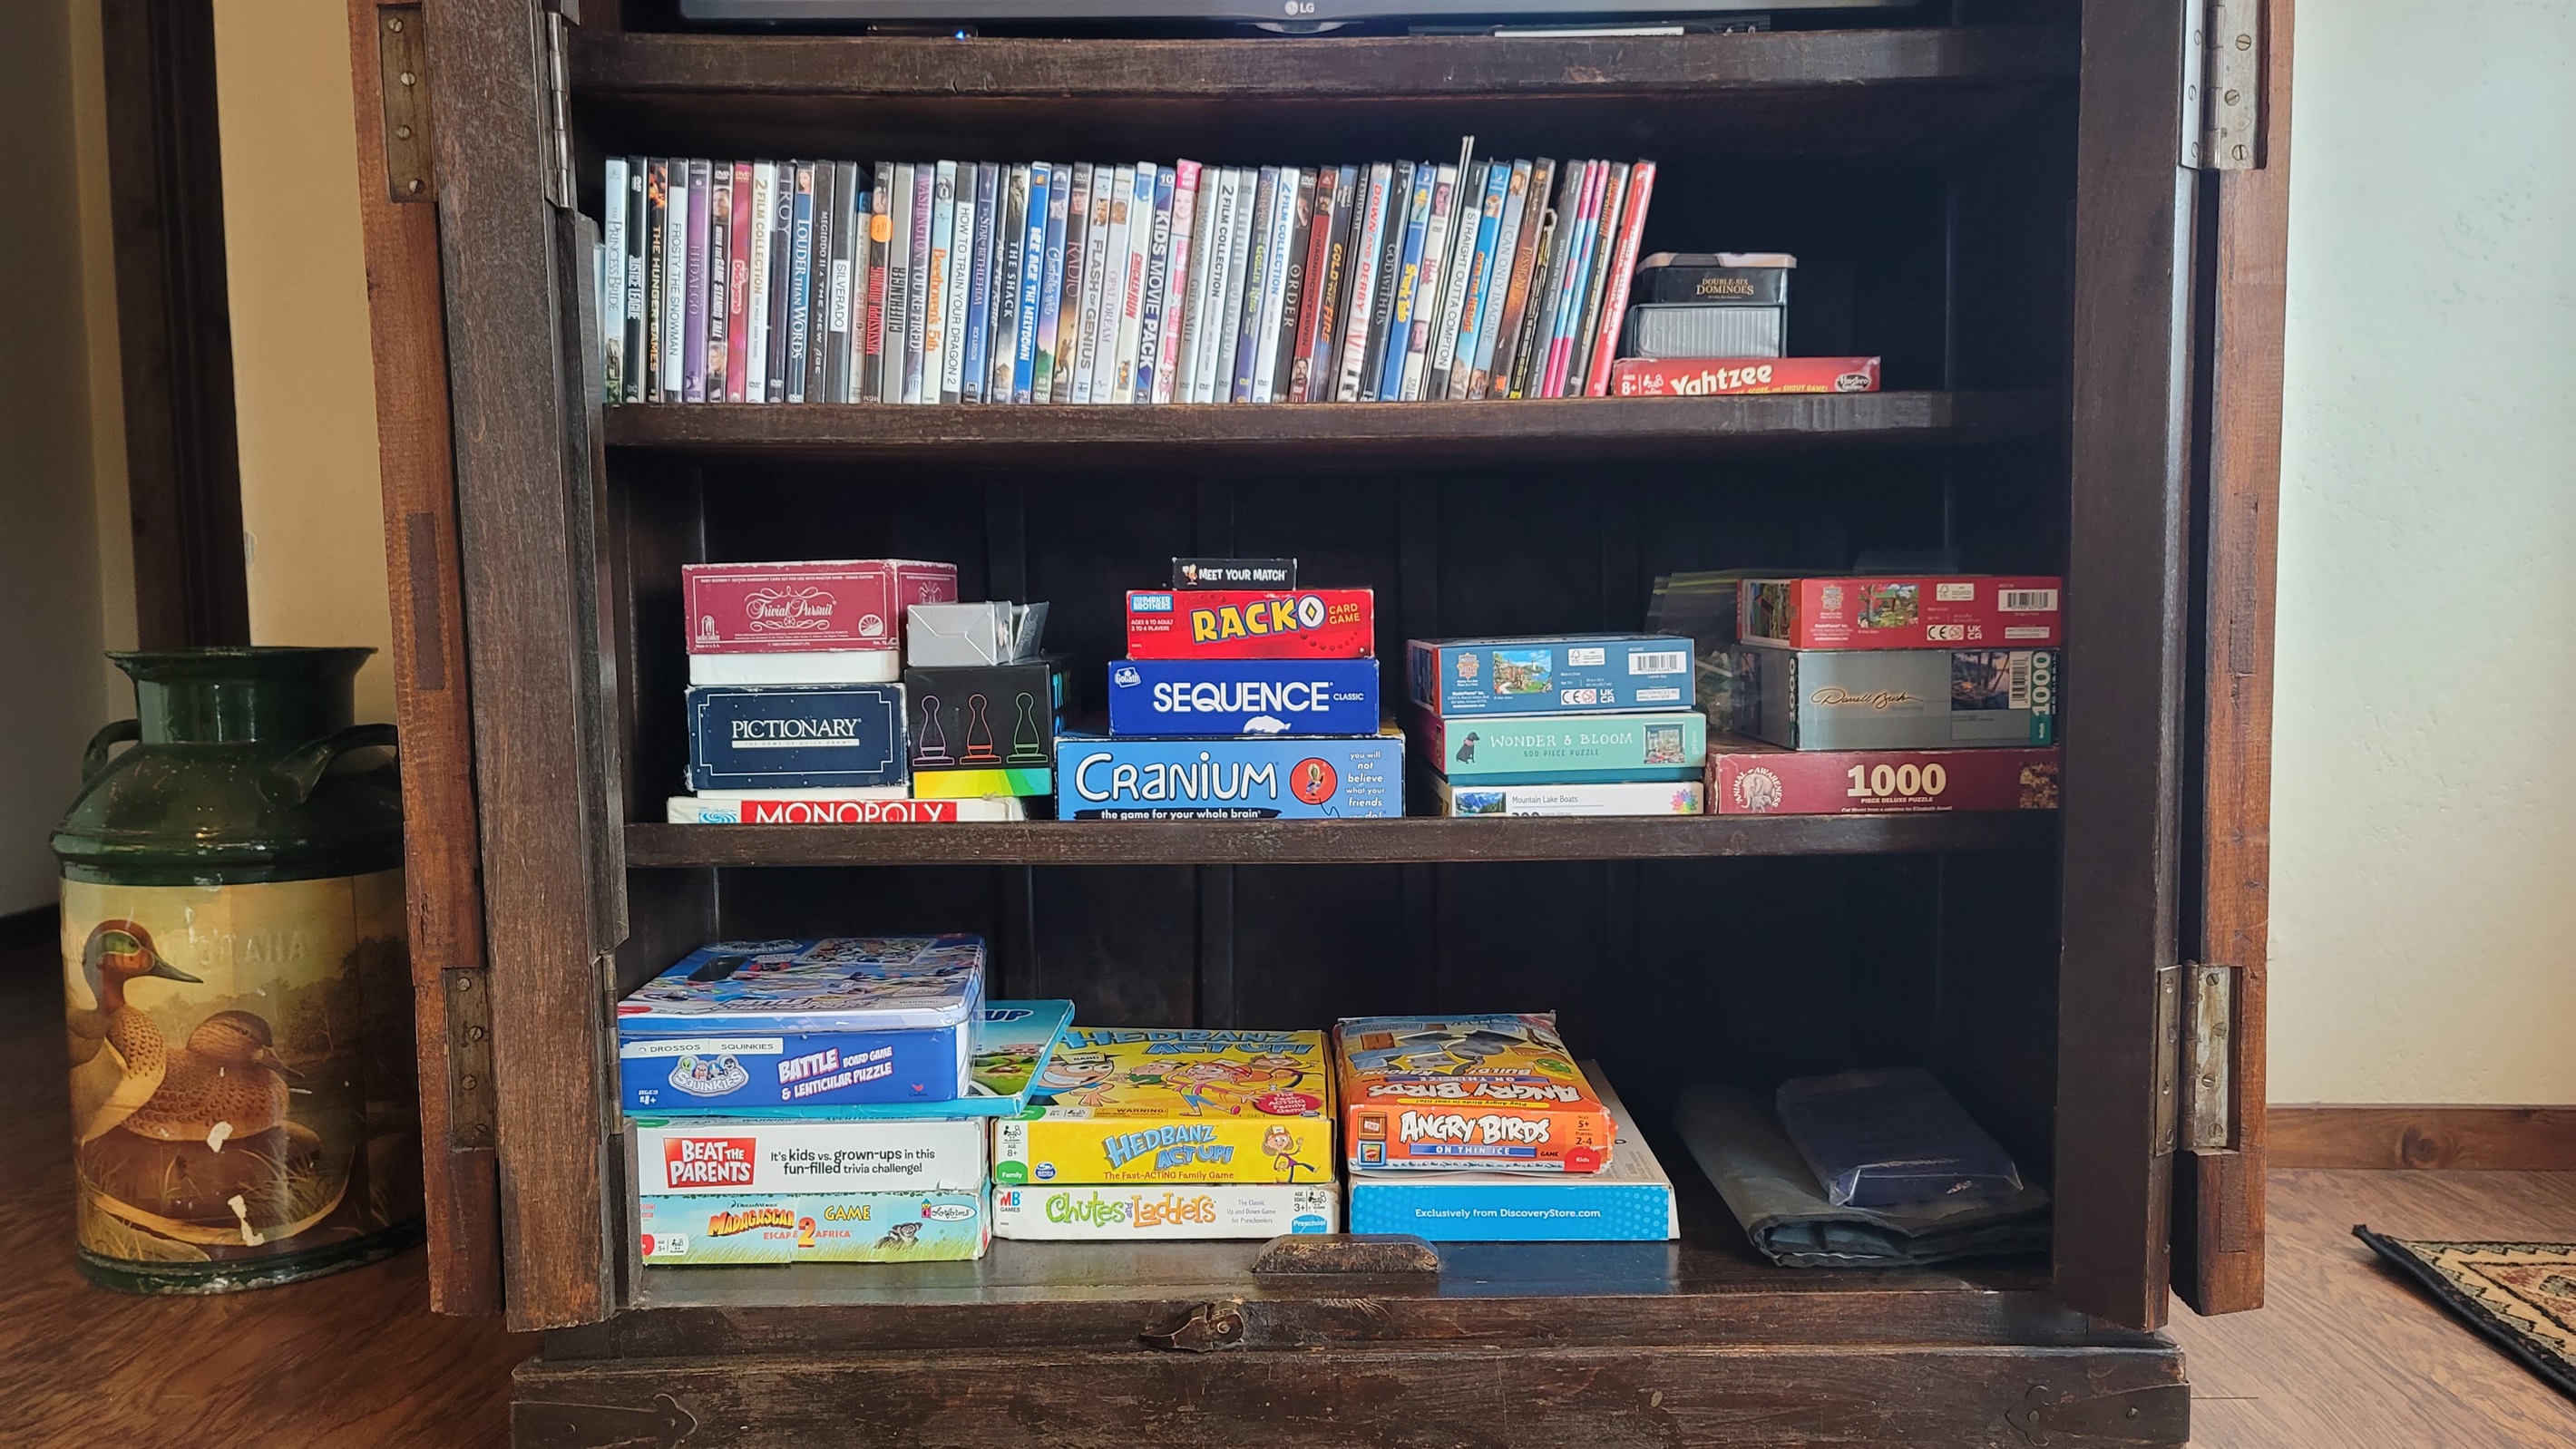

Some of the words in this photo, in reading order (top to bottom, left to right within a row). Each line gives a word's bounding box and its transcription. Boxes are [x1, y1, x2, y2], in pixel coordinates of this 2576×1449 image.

[1300, 2, 1315, 14] LG
[755, 180, 768, 190] 2
[756, 192, 766, 219] FILM
[912, 176, 930, 263] WASHINGTON,
[1368, 184, 1382, 232] DOWN
[958, 208, 970, 236] HOW
[1152, 209, 1169, 256] KIDS
[608, 221, 623, 276] PRINCESS
[652, 226, 661, 254] THE
[671, 222, 682, 267] FROSTY
[795, 219, 809, 276] LOUDER
[957, 238, 968, 254] TO
[1029, 227, 1041, 252] ICE
[1364, 235, 1373, 258] AND
[1458, 211, 1477, 267] STRAIGHT
[1499, 229, 1513, 255] CAN
[754, 222, 766, 295] COLLECTION
[1009, 241, 1020, 267] THE
[1027, 254, 1040, 282] AGE
[1089, 238, 1103, 292] FLASH
[1472, 250, 1486, 278] OVER
[628, 255, 642, 288] JUSTICE
[670, 272, 681, 295] THE
[688, 246, 701, 315] HIDALGO
[954, 257, 967, 290] TRAIN
[1066, 242, 1082, 297] RADIO
[1493, 258, 1509, 291] ONLY
[1702, 277, 1749, 286] DOUBLE-SIX
[608, 276, 622, 311] BRIDE
[650, 257, 661, 318] HUNGER
[793, 277, 804, 305] THAN
[834, 264, 847, 328] SILVERADO
[889, 267, 906, 333] CLIFFHANGER
[911, 265, 927, 311] YOU'RE
[928, 248, 946, 325] Beethoven's
[1004, 271, 1016, 318] SHACK
[1024, 284, 1037, 305] THE
[1088, 294, 1097, 306] OF
[1147, 259, 1166, 315] MOVIE
[1283, 263, 1302, 328] ORDER
[1355, 262, 1371, 315] DERBY
[1449, 270, 1467, 308] OUTTA
[1470, 279, 1479, 295] THE
[1695, 284, 1754, 296] DOMINOES
[627, 288, 642, 320] LEAGUE
[951, 293, 964, 325] YOUR
[1462, 297, 1478, 333] HEDGE
[1483, 292, 1503, 343] IMAGINE
[668, 295, 681, 355] SNOWMAN
[792, 306, 806, 359] WORDS
[909, 314, 923, 353] FIRED!
[1019, 305, 1035, 361] MELTDOWN
[1080, 308, 1097, 370] GENIUS
[1438, 310, 1458, 366] COMPTON
[649, 322, 659, 372] GAMES
[926, 328, 941, 353] 5th
[948, 327, 961, 375] DRAGON
[1139, 317, 1158, 370] PACK
[947, 377, 957, 385] 2
[1669, 365, 1773, 394] Yahtzee
[1198, 568, 1223, 580] MEET
[1225, 569, 1251, 581] YOUR
[1253, 569, 1286, 581] MATCH
[746, 598, 789, 619] Trivial
[789, 598, 834, 618] Pursuit
[1329, 604, 1359, 615] CARD
[1329, 613, 1361, 625] GAME
[1153, 682, 1330, 713] SEQUENCE
[1333, 693, 1364, 701] CLASSIC
[731, 719, 858, 739] PICTIONARY
[1489, 734, 1556, 748] WONDER
[1564, 734, 1574, 745] &
[1580, 732, 1633, 745] BLOOM
[1350, 753, 1365, 761] you
[1357, 762, 1373, 770] not
[1523, 750, 1539, 758] 500
[1543, 749, 1566, 757] PIECE
[1569, 748, 1600, 757] PUZZLE
[1346, 786, 1365, 794] what
[1348, 773, 1383, 783] believe
[1847, 763, 1947, 797] 1000
[755, 802, 943, 822] MONOPOLY
[1349, 796, 1382, 807] friends
[1512, 795, 1541, 804] Mountain
[1543, 794, 1558, 803] Lake
[1560, 794, 1578, 803] Boats
[1101, 809, 1118, 820] the
[1120, 812, 1149, 821] game
[1153, 809, 1168, 820] for
[1170, 811, 1194, 821] your
[1196, 808, 1228, 819] whole
[1230, 808, 1259, 819] brain
[649, 1044, 701, 1053] DROSSOS
[721, 1043, 774, 1051] SQUINKIES
[777, 1047, 839, 1084] BATTLE
[843, 1052, 869, 1068] BOARD
[869, 1045, 893, 1062] GAME
[781, 1088, 791, 1101] &
[794, 1074, 852, 1099] LENTICULAR
[853, 1062, 893, 1084] PUZZLE
[1400, 1109, 1477, 1143] ANGRY
[1476, 1113, 1551, 1145] BIRDS
[681, 1141, 727, 1162] BEAT
[725, 1148, 745, 1161] THE
[770, 1152, 787, 1162] It's
[788, 1148, 815, 1162] kids
[817, 1152, 832, 1161] vs.
[834, 1148, 903, 1164] grown-ups
[904, 1149, 914, 1160] in
[915, 1149, 936, 1160] this
[1103, 1123, 1218, 1169] HEDBANZ
[1155, 1145, 1196, 1170] ACT
[1196, 1144, 1234, 1163] UP!
[1435, 1145, 1452, 1154] ON
[1457, 1145, 1486, 1155] THIN
[1491, 1146, 1510, 1155] ICE
[669, 1162, 752, 1185] PARENTS
[783, 1162, 841, 1175] fun-filled
[844, 1163, 870, 1174] trivia
[872, 1162, 922, 1176] challenge!
[1001, 1172, 1023, 1181] Family
[1122, 1171, 1176, 1179] Fast-ACTING
[1178, 1171, 1207, 1181] Family
[824, 1205, 871, 1221] GAME
[1046, 1191, 1127, 1228] Chutes
[1133, 1191, 1217, 1229] Ladders
[1415, 1207, 1470, 1220] Exclusively
[1472, 1208, 1498, 1217] from
[1499, 1207, 1601, 1220] DiscoveryStore.com
